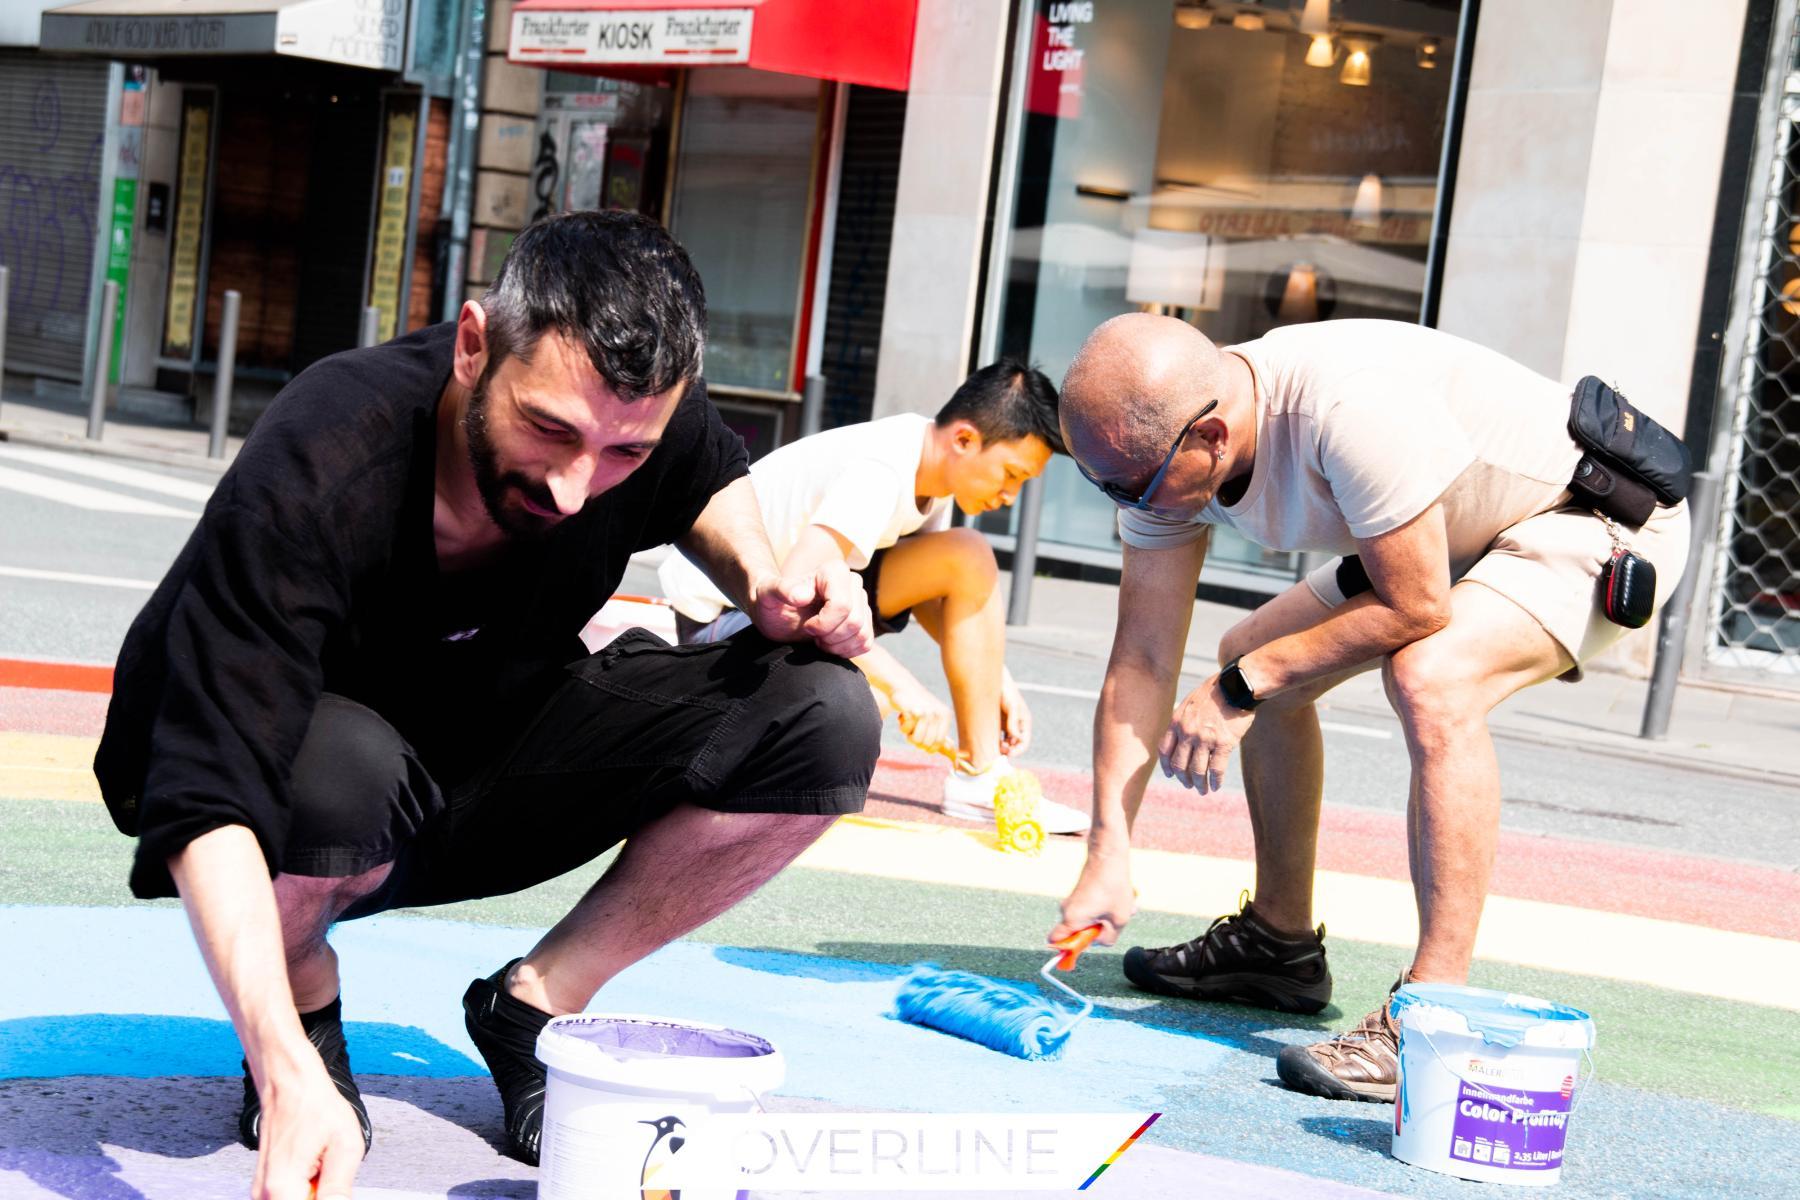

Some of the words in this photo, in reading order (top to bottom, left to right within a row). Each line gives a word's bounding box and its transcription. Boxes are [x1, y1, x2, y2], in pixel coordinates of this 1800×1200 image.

[1048, 1, 1093, 23] LIVING
[522, 16, 589, 37] Frankfurter
[599, 22, 653, 50] KIOSK
[665, 16, 740, 37] Frankfurter
[1047, 25, 1076, 48] THE
[1043, 48, 1084, 71] LIGHT
[1460, 1100, 1509, 1123] Color
